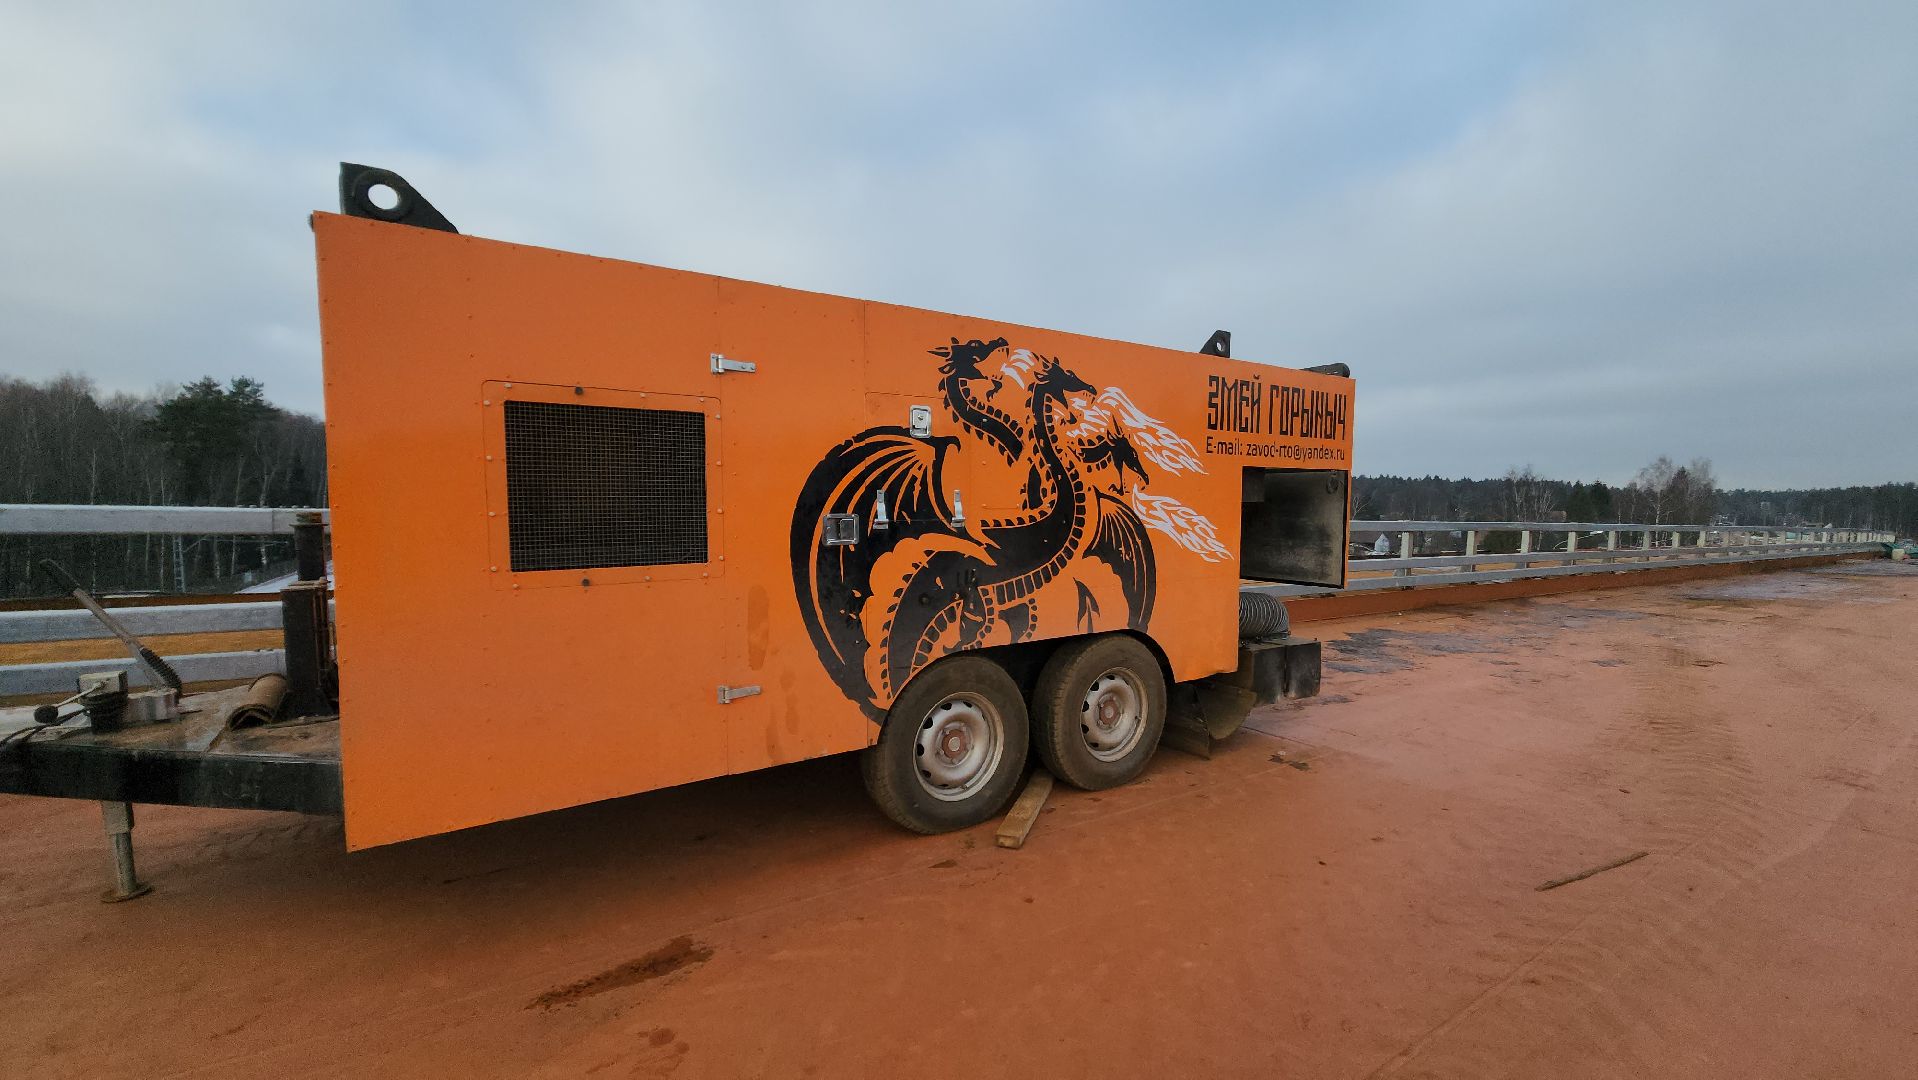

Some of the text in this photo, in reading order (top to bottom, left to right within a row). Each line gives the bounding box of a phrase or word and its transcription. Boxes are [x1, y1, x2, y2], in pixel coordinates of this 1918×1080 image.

[1207, 374, 1347, 440] ЗМЕЙ ГОРЫНЫЧ
[1206, 436, 1345, 462] E-mail: zavod-rto@yandex.ru
